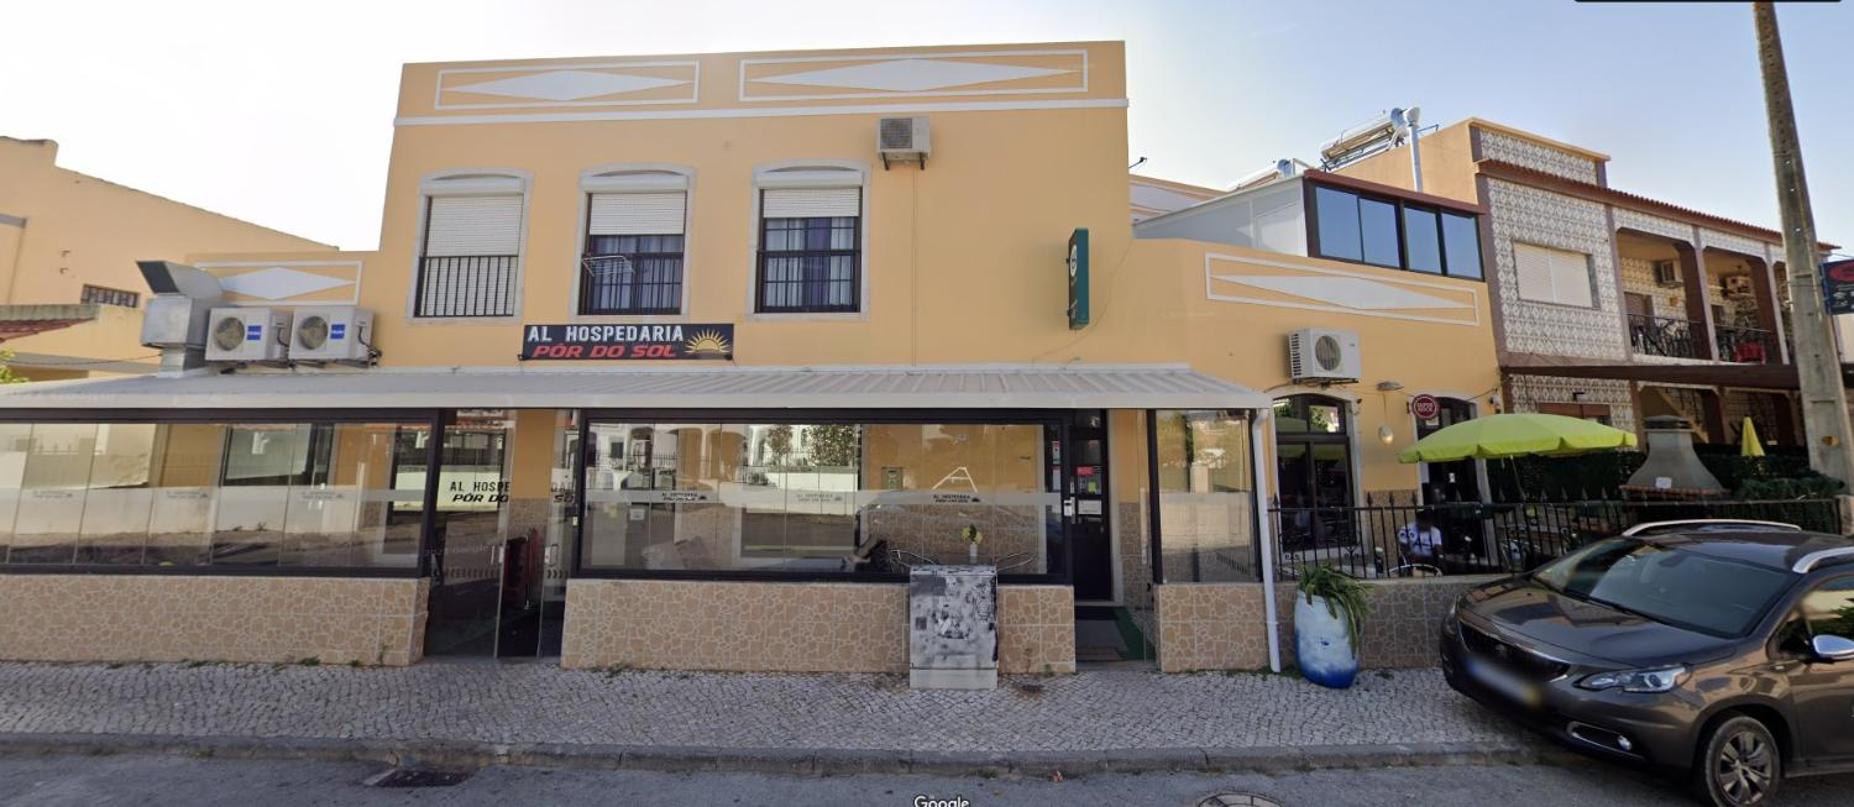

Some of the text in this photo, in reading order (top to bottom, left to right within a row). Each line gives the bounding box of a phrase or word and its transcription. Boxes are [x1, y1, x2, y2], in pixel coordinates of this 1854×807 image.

[527, 325, 684, 342] AL HOSPEDARIA
[589, 345, 625, 358] DO
[630, 344, 677, 358] SOL
[450, 481, 465, 492] AL
